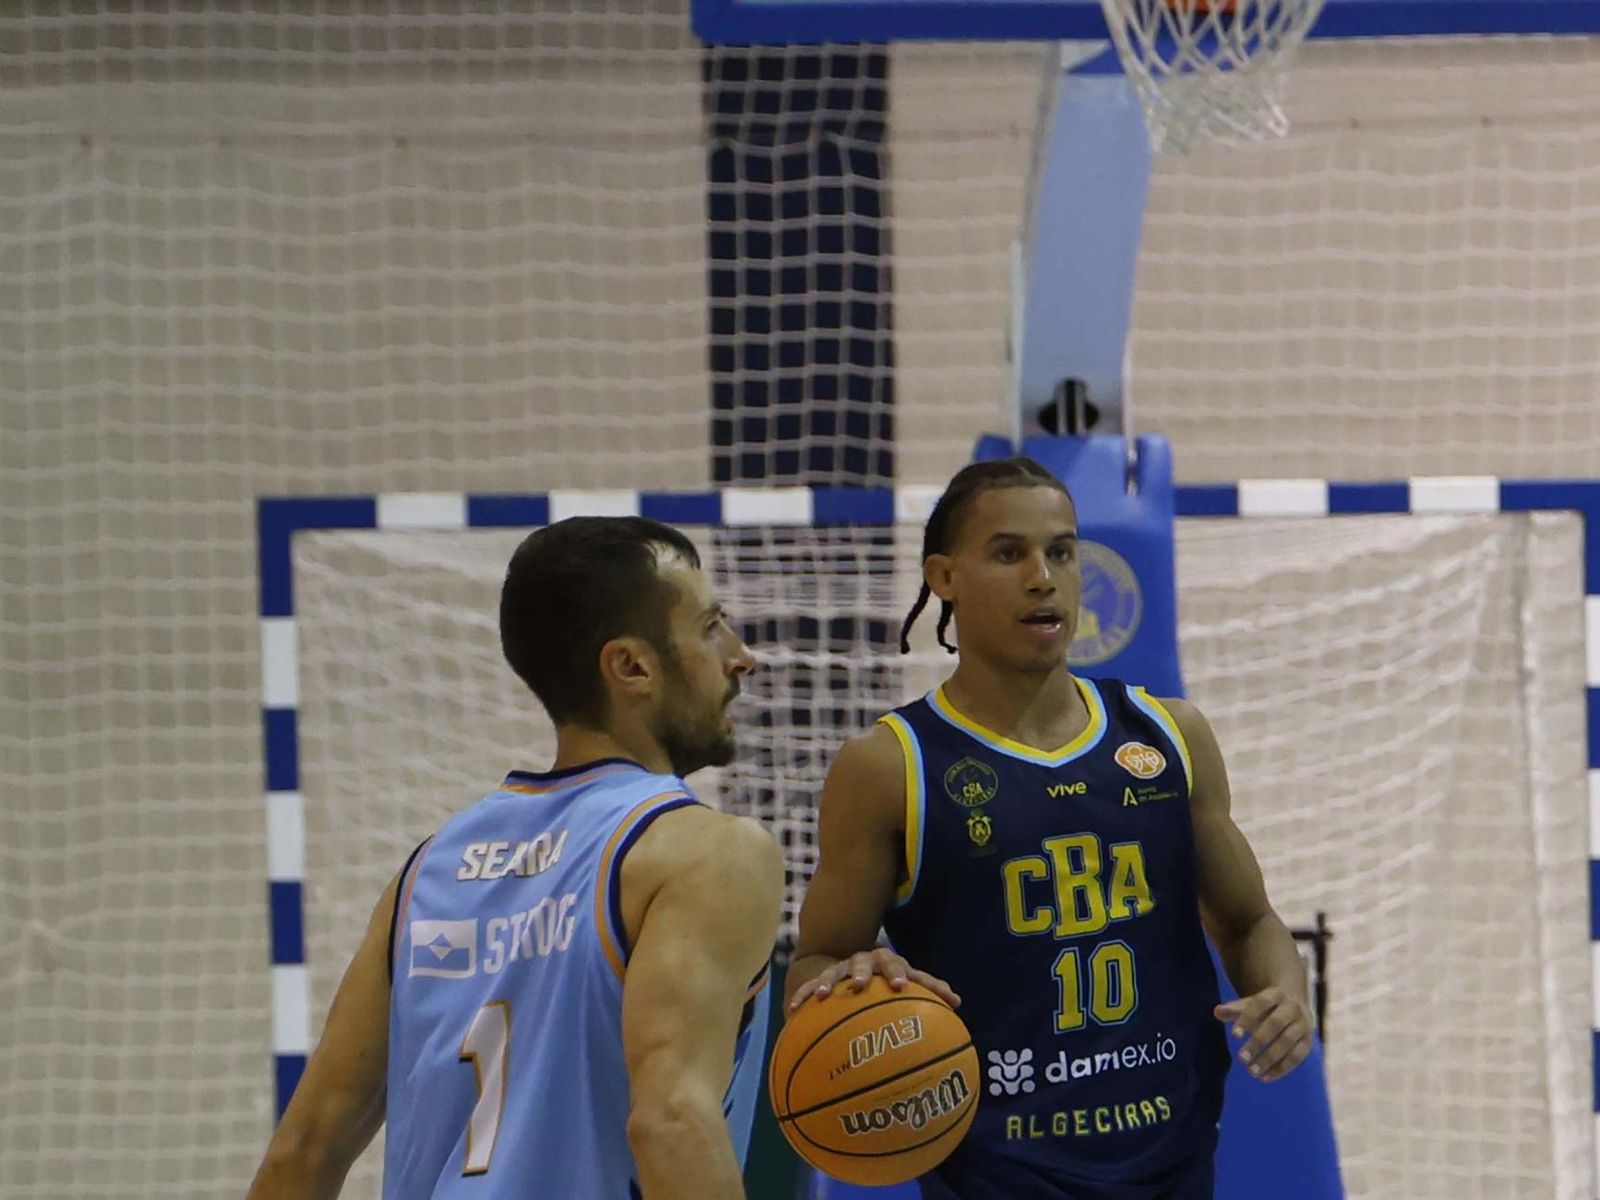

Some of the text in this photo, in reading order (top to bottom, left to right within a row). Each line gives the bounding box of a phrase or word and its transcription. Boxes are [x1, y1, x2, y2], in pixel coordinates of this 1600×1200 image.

[1047, 782, 1087, 798] vive
[1001, 832, 1156, 940] CBA
[1051, 940, 1137, 1034] 10
[458, 1001, 511, 1177] 1
[1045, 1032, 1176, 1083] damex.io
[838, 1068, 970, 1136] Wilson
[1006, 1096, 1171, 1141] ALGECIRAS
